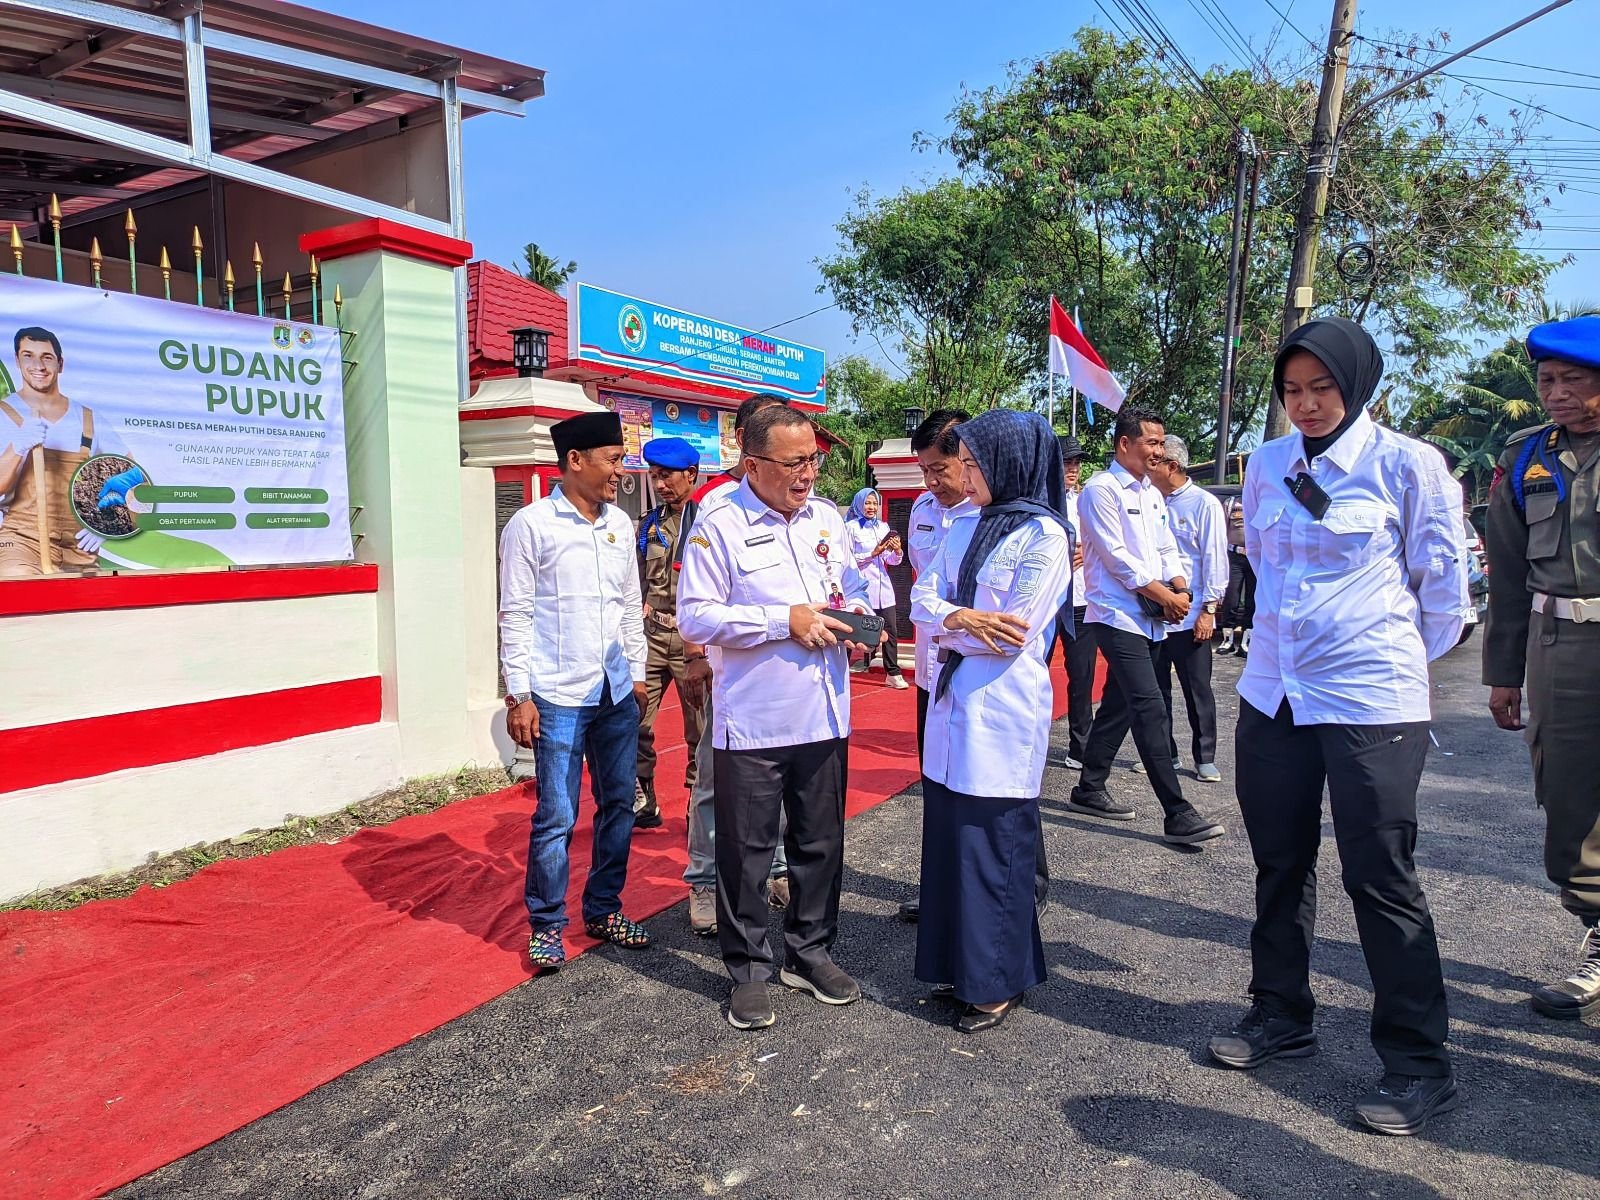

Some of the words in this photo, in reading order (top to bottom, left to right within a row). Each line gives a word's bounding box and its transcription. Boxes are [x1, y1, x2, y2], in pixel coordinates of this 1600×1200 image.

[653, 311, 712, 338] KOPERASI
[714, 326, 742, 346] DESA
[742, 336, 776, 355] MERAH
[777, 344, 804, 362] PUTIH
[680, 334, 712, 349] RANJENG
[740, 350, 761, 362] SERANG
[763, 355, 786, 367] BANTEN
[158, 339, 322, 386] GUDANG
[659, 341, 696, 357] BERSAMA
[697, 349, 740, 368] MEMBANGUN
[740, 359, 785, 378] PEREKONOMIAN
[785, 370, 801, 381] DESA
[206, 383, 325, 421] PUPUK
[124, 417, 175, 429] KOPERASI
[177, 421, 203, 431] DESA
[205, 423, 237, 433] MERAH
[239, 425, 265, 435] PUTIH
[266, 427, 288, 437] DESA
[289, 429, 327, 439] RANJENG
[174, 443, 224, 454] GUNAKAN
[225, 446, 256, 456] PUPUK
[256, 448, 281, 457] YANG
[282, 449, 308, 459] TEPAT
[309, 451, 330, 459] AGAR
[182, 456, 211, 465] HASIL
[212, 457, 244, 466] PANEN
[245, 458, 270, 467] LEBIH
[173, 491, 199, 499] PUPUK
